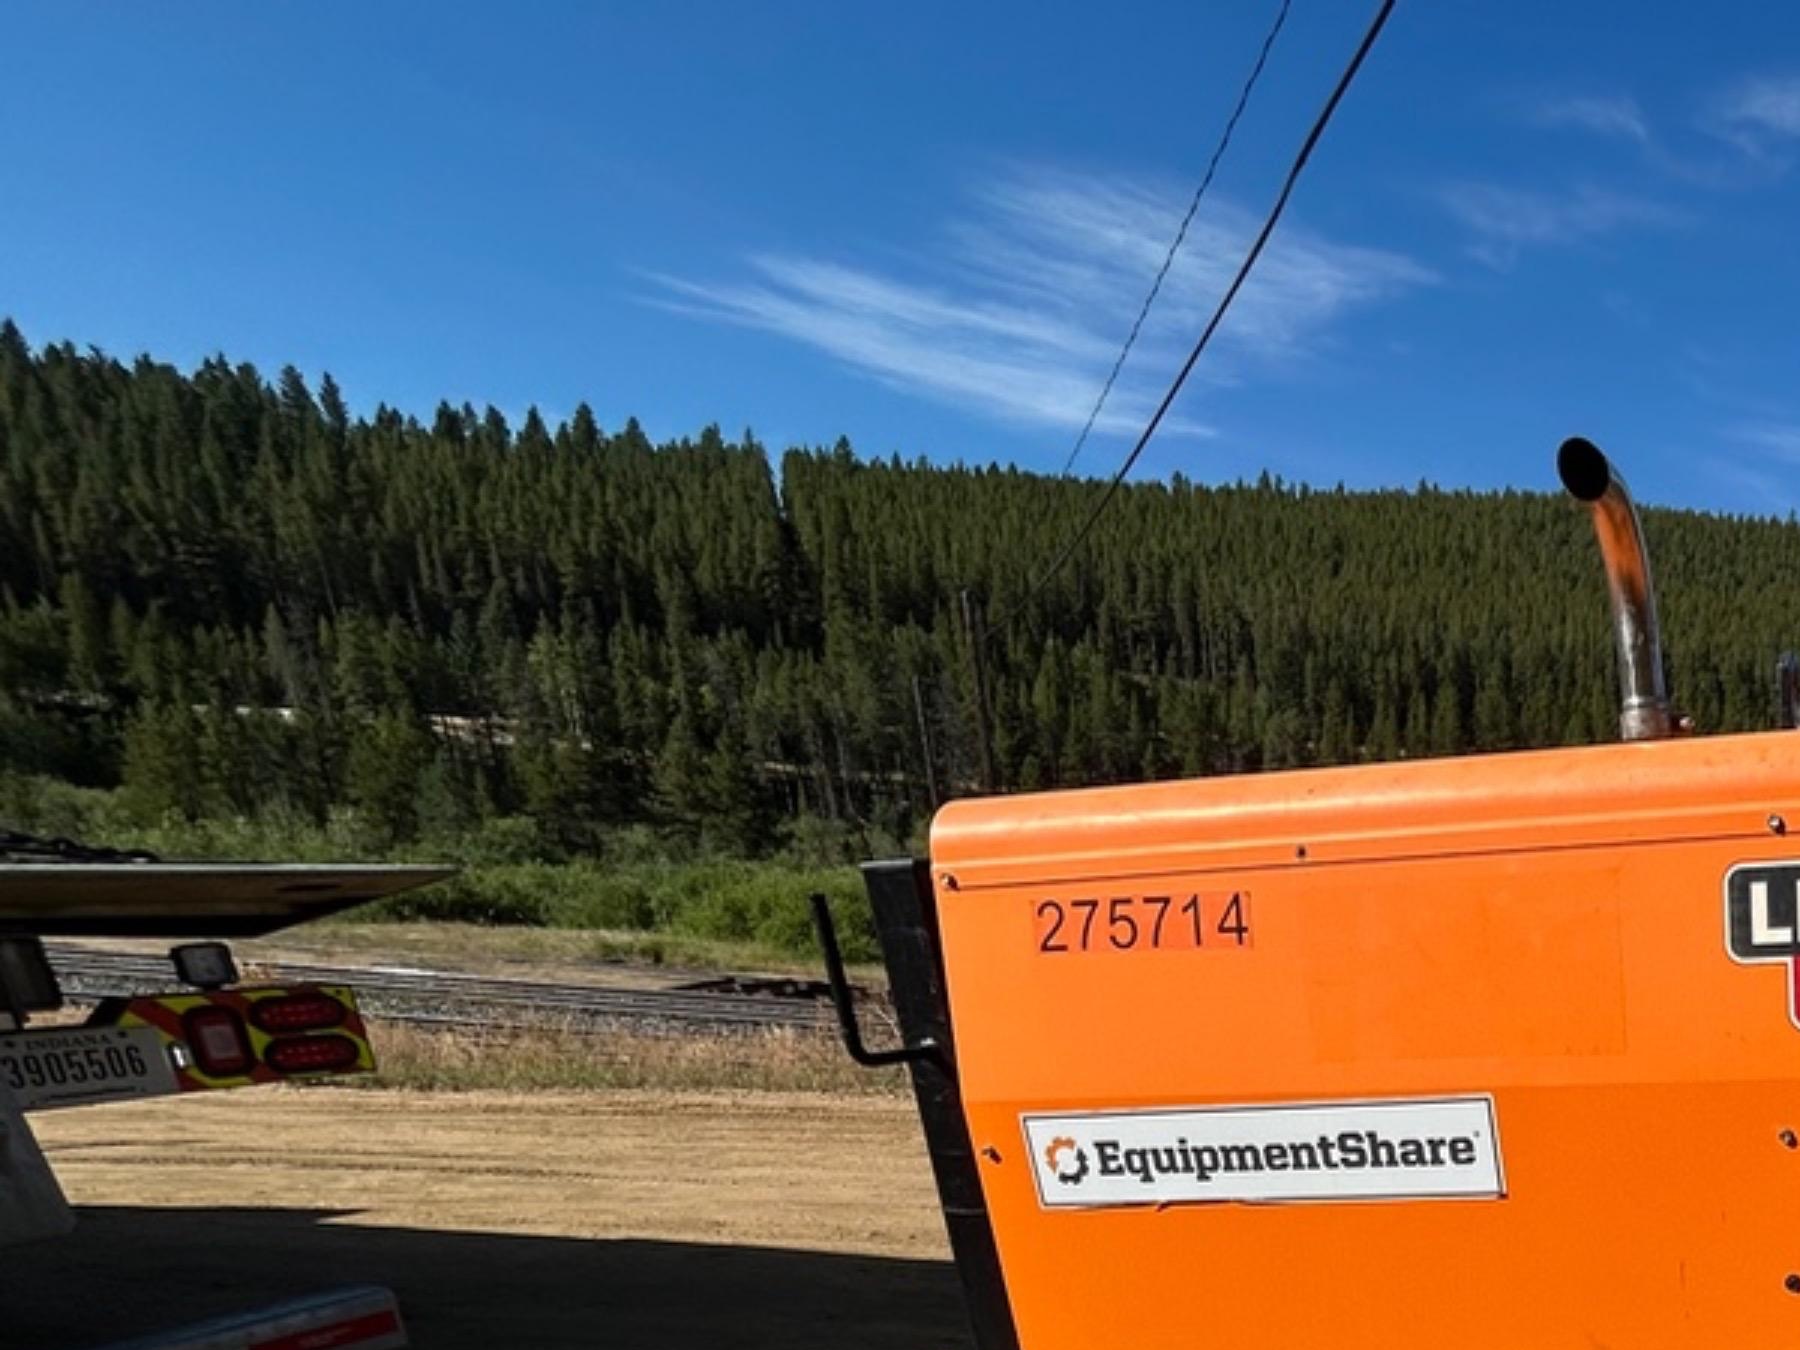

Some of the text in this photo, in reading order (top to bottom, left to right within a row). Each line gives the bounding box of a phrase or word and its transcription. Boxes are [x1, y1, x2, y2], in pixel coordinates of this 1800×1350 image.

[1036, 892, 1250, 953] 275714
[25, 1032, 112, 1051] INDIANA
[1095, 1130, 1476, 1183] EquipmentShare
